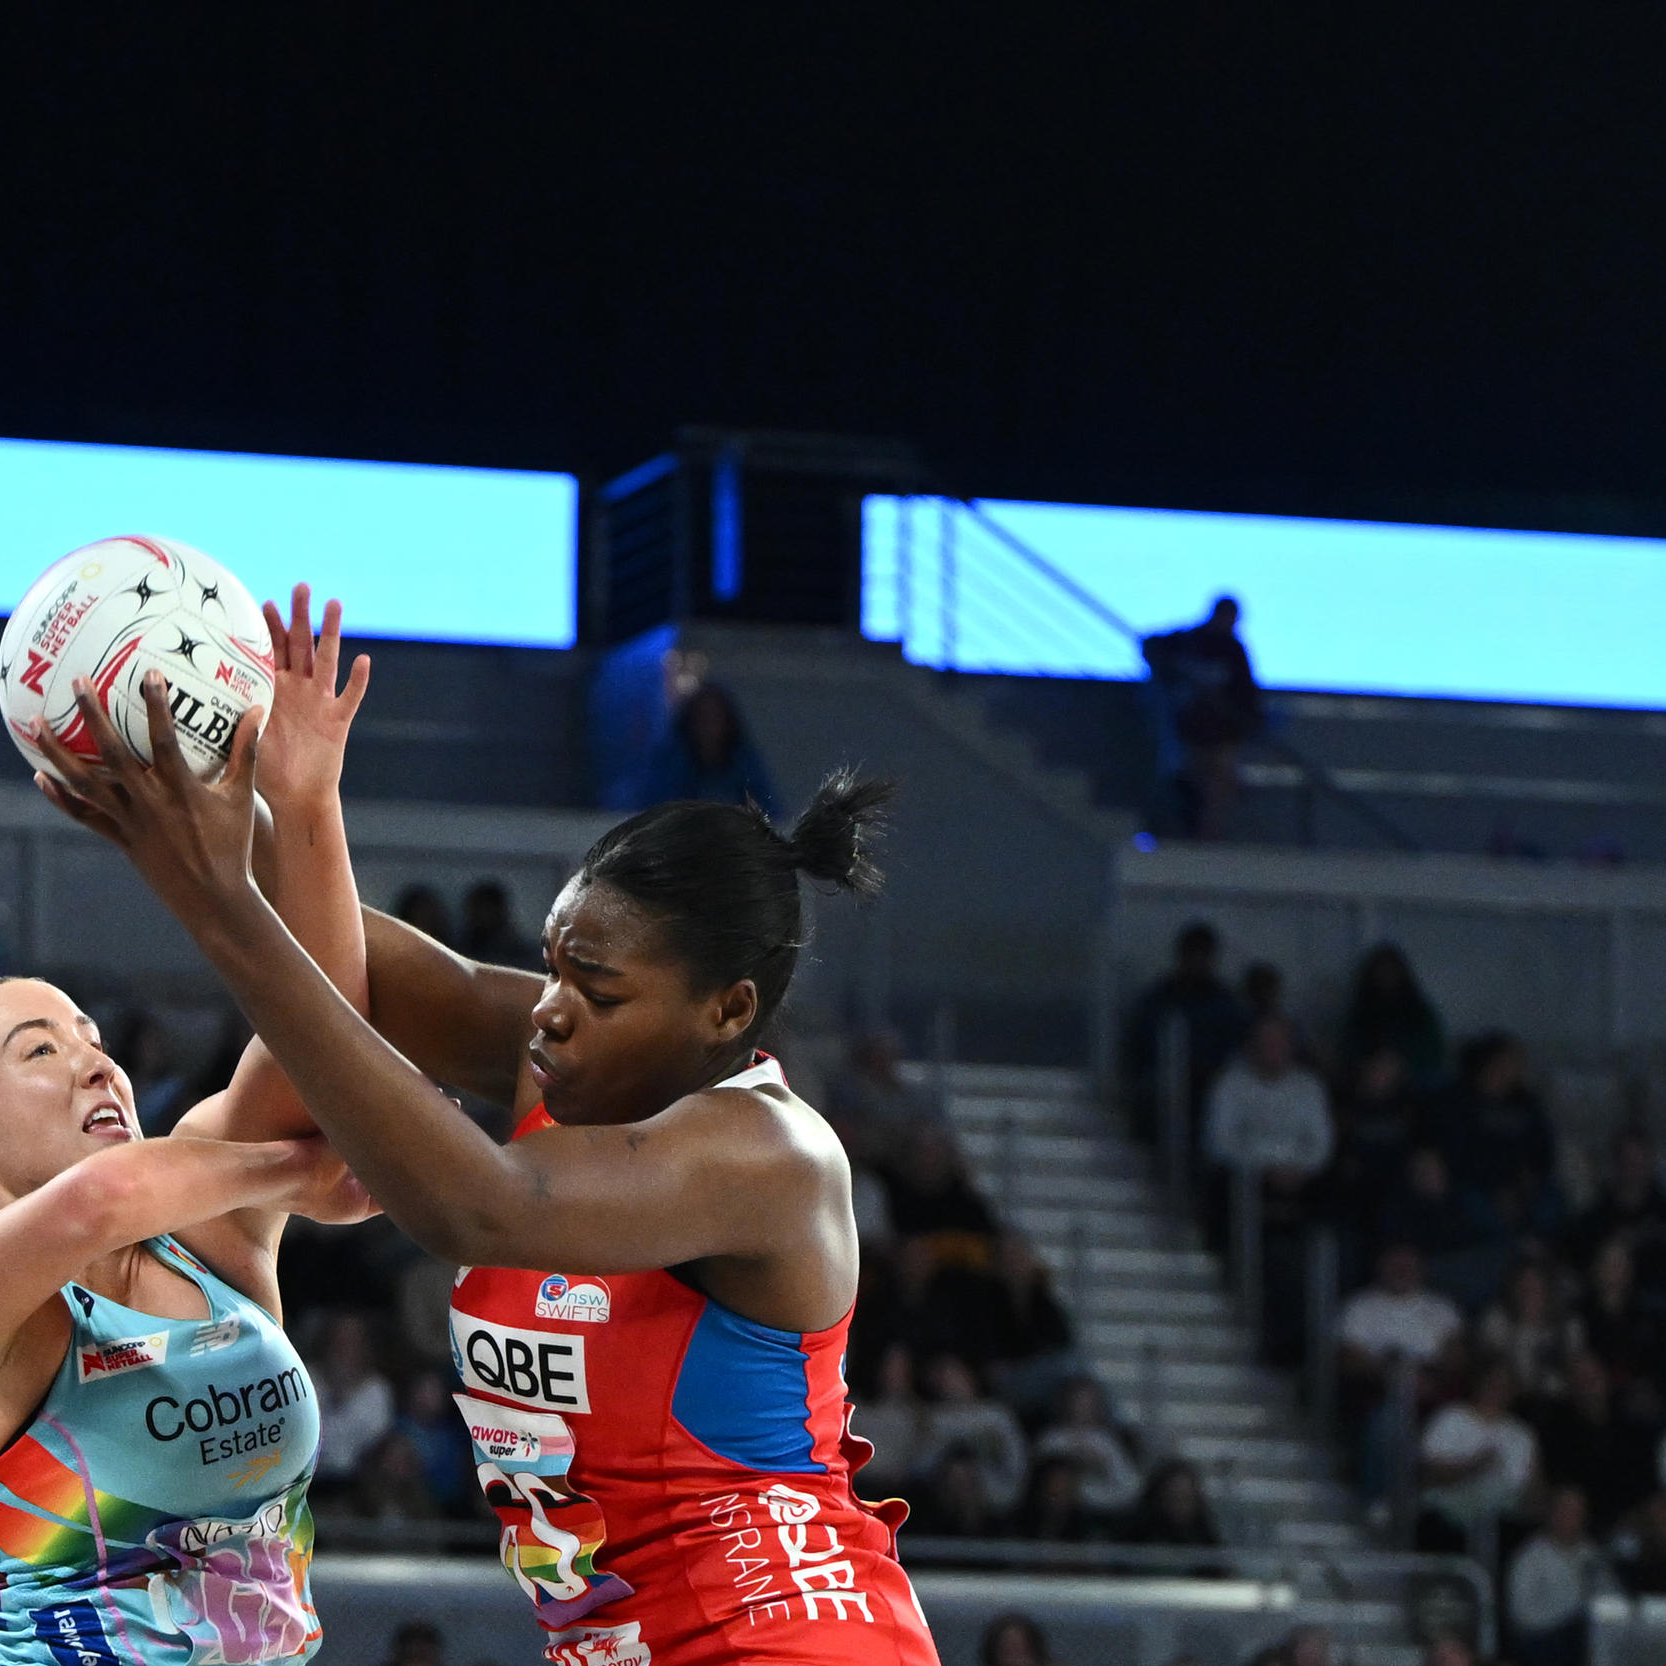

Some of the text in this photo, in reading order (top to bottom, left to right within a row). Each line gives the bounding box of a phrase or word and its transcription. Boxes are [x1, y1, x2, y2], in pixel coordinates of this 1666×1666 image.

[41, 602, 74, 650] SUPER
[50, 594, 99, 657] NETBALL
[536, 1302, 610, 1323] SWIFTS
[566, 1292, 605, 1306] nsw
[467, 1329, 578, 1405] QBE
[145, 1367, 307, 1441] Cobram
[200, 1420, 283, 1465] Estate
[471, 1425, 520, 1446] aware
[489, 1444, 517, 1457] super
[778, 1523, 874, 1623] QBE
